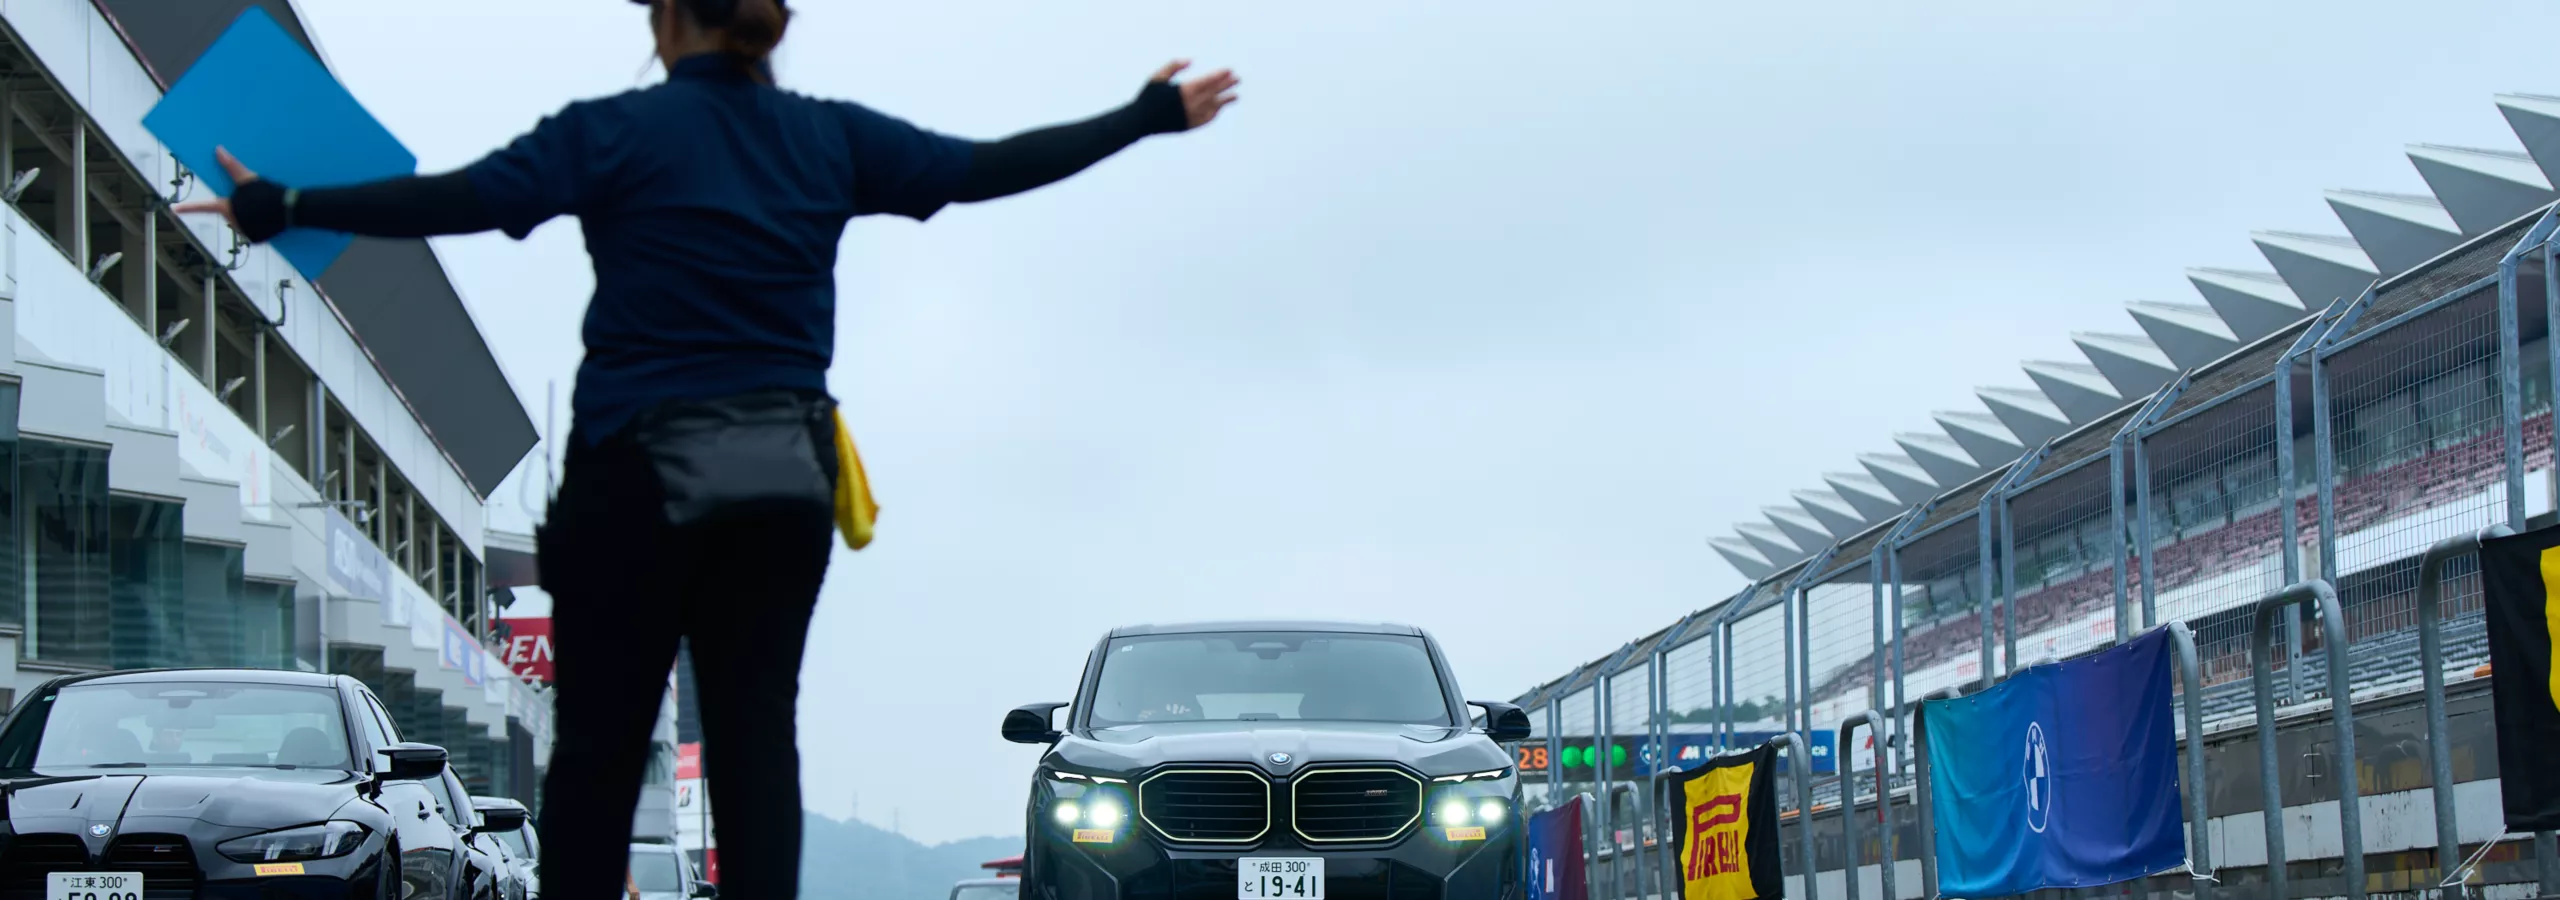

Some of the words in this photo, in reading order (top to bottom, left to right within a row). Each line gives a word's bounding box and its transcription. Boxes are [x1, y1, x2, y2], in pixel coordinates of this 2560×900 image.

[1519, 747, 1549, 770] 28
[1259, 861, 1282, 873] 成田
[1285, 861, 1306, 873] 300
[70, 877, 97, 889] 江東
[99, 876, 123, 889] 300
[1244, 881, 1254, 893] と
[1261, 875, 1316, 898] 19-41
